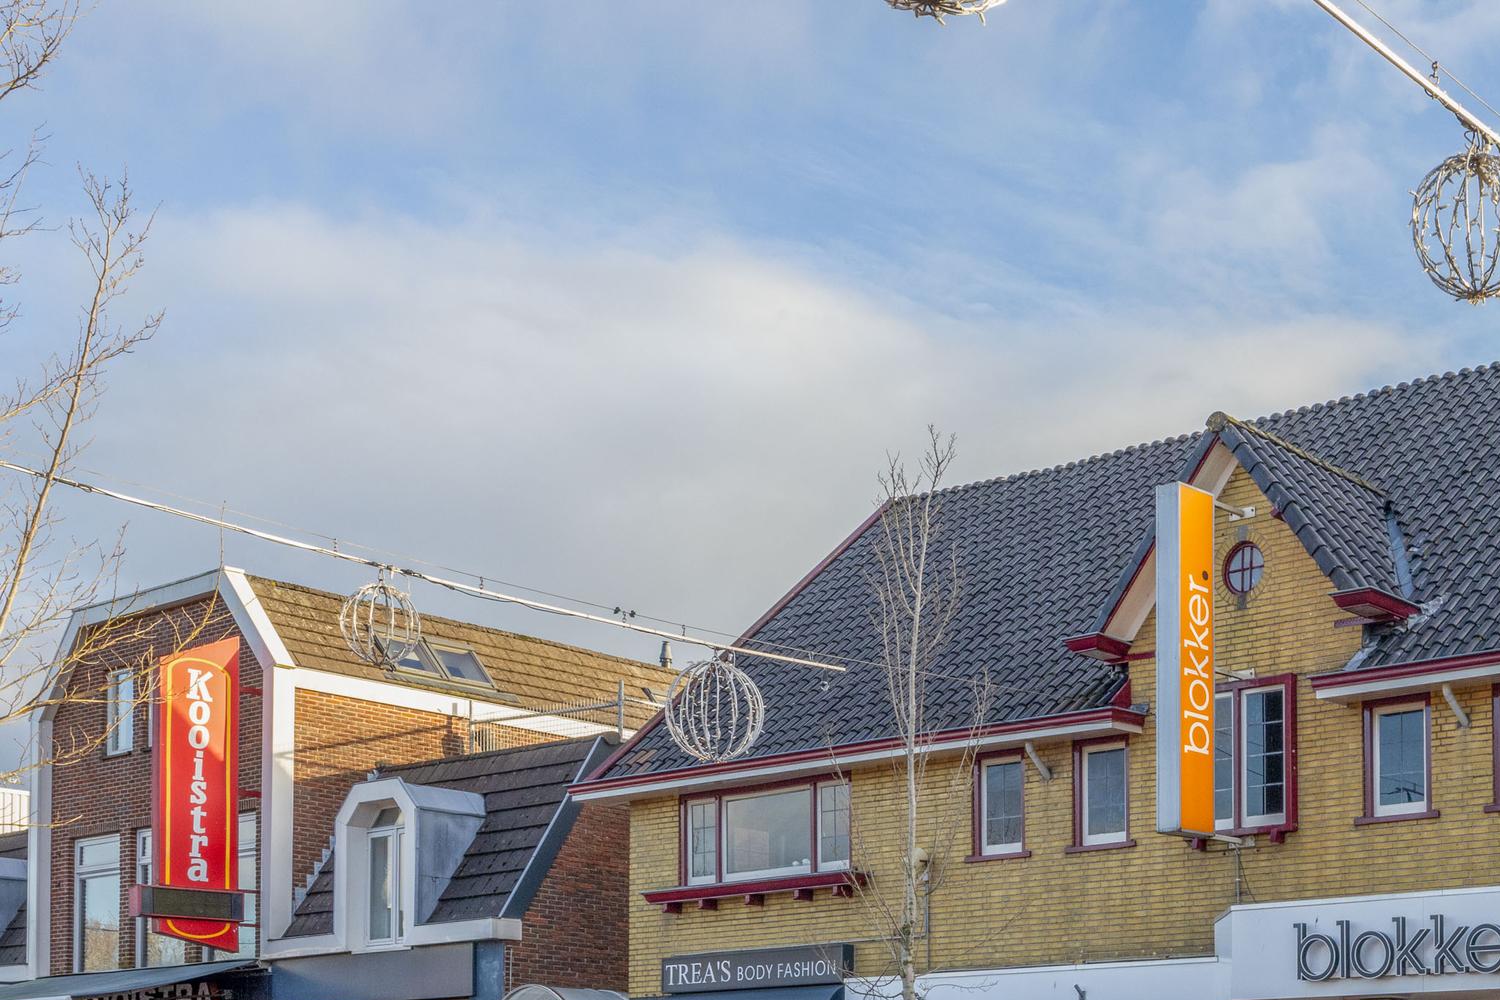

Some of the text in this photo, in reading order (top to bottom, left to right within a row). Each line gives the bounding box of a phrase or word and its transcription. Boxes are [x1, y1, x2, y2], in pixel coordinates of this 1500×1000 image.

[1183, 570, 1211, 756] blokker.
[186, 667, 214, 883] Kooistra
[665, 959, 837, 986] TREA'S BODY FASHION
